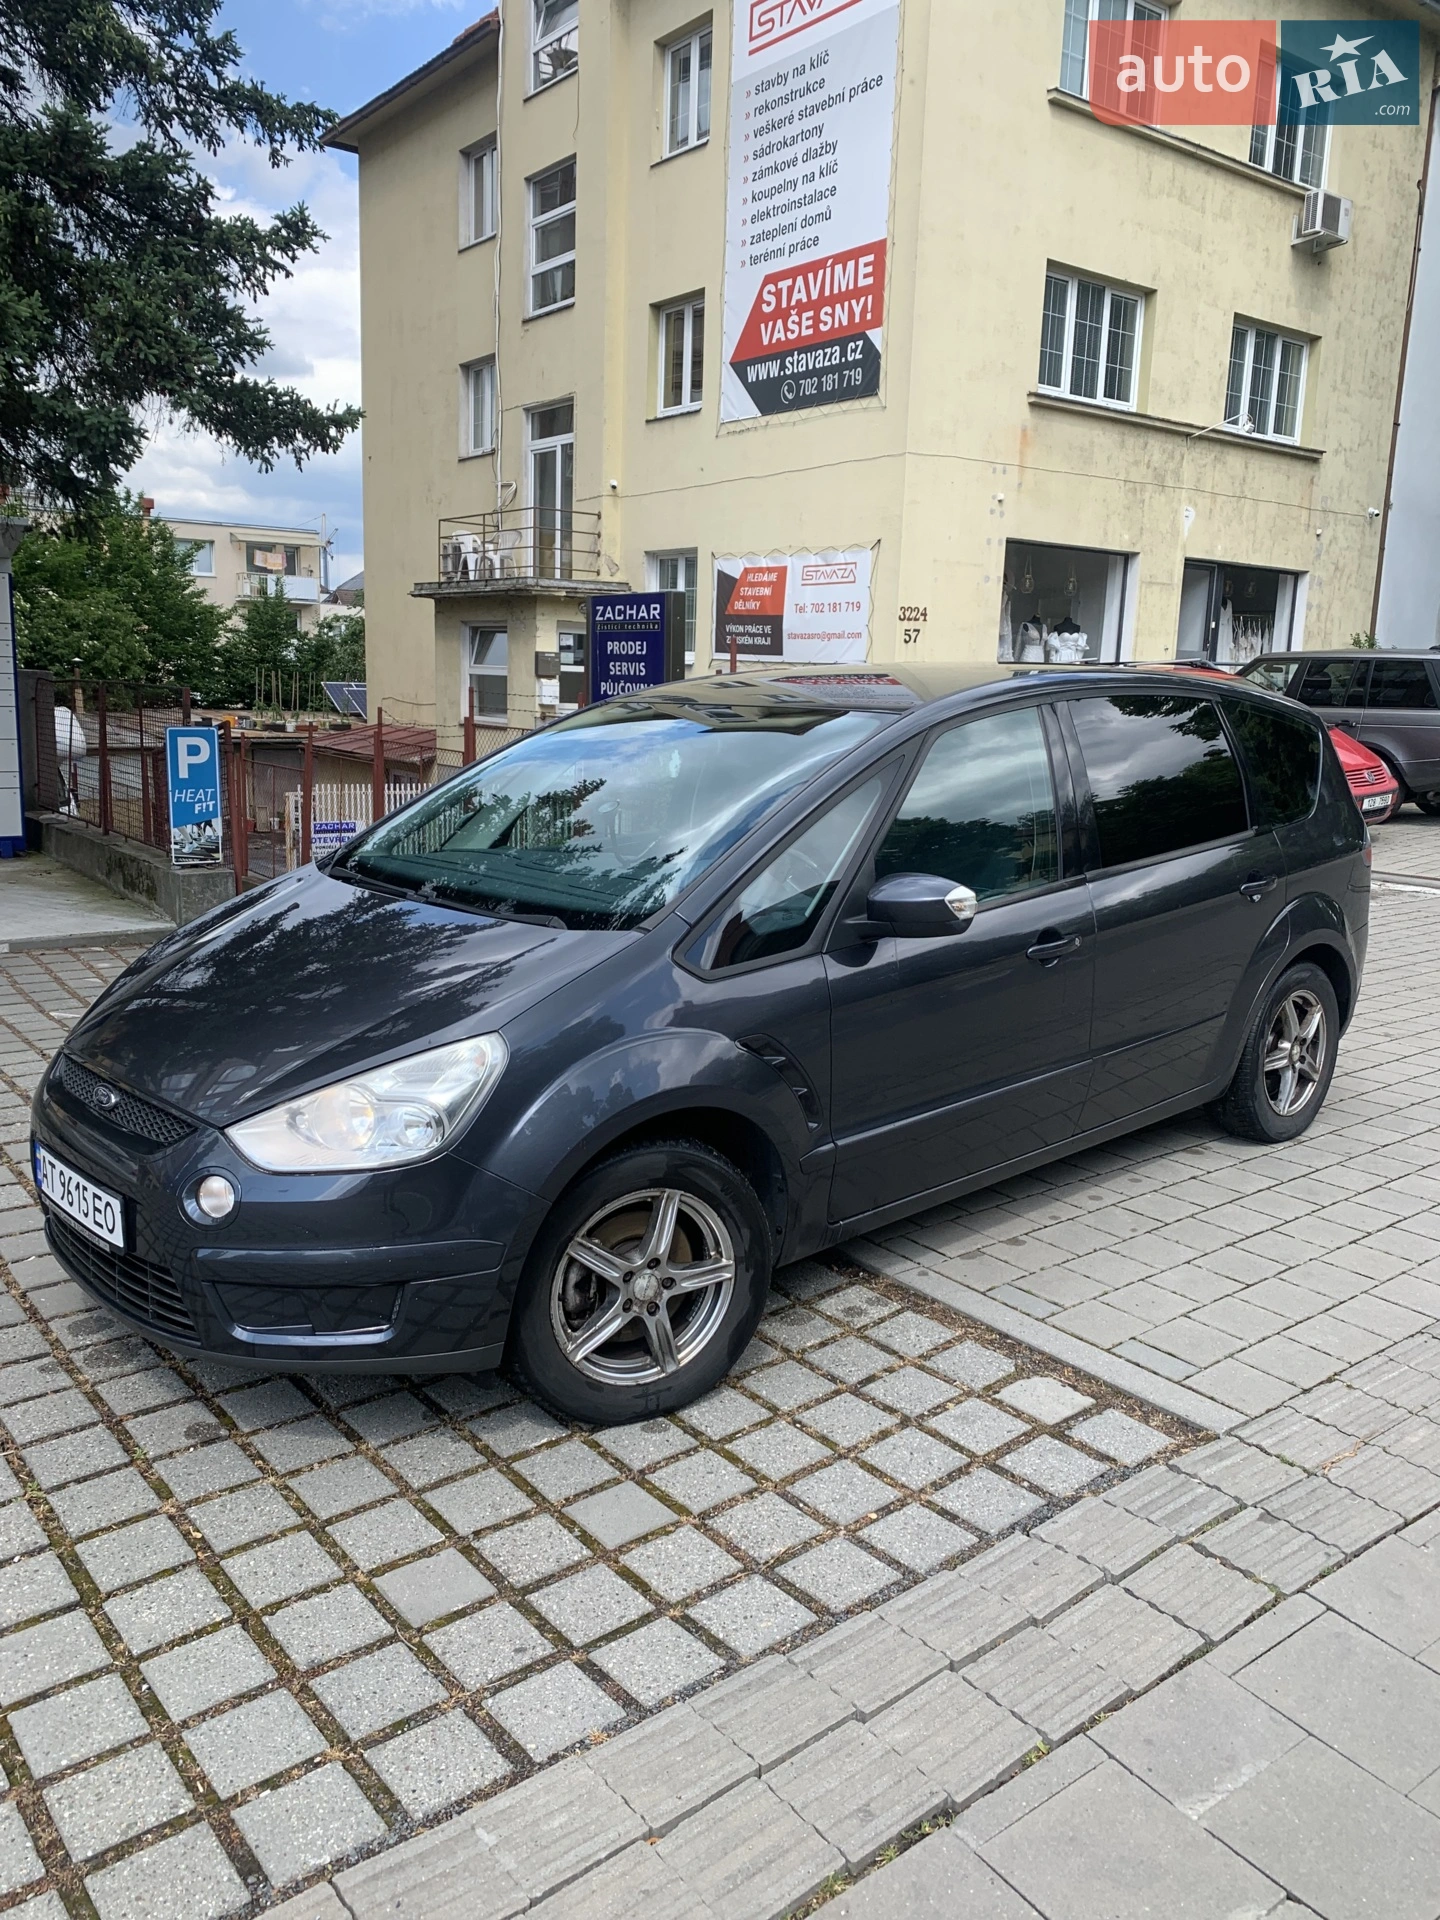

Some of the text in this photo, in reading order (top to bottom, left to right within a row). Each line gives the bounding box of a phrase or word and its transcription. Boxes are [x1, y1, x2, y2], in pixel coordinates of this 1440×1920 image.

[754, 49, 830, 95] stavby na klíč
[753, 74, 883, 139] veškeré stavební práce
[754, 78, 825, 117] rekonstrukce
[753, 122, 824, 160] sádrokartony
[752, 138, 838, 182] zámkové dlažby
[751, 159, 838, 203] koupelny na klíč
[751, 185, 837, 225] elektroinstalace
[750, 205, 832, 246] zateplení domů
[749, 235, 819, 266] terénní práce
[761, 254, 875, 313] STAVÍME
[760, 295, 872, 346] VAŠE SNY!
[747, 340, 863, 382] www.stavaza.cz
[799, 367, 862, 396] 702 181 719
[747, 571, 778, 582] HLEDÁME
[802, 566, 857, 582] STAVAZA
[740, 585, 772, 596] STAVEBNÍ
[595, 604, 660, 620] ZACHAR
[734, 599, 761, 610] DĚLNÍKY
[794, 601, 861, 613] Tel: 702 181 719
[898, 606, 928, 622] 3224
[624, 622, 659, 630] technika
[725, 623, 772, 634] VÝKON PRÁCE VE
[787, 630, 862, 641] stavazasro@gmail.com
[903, 628, 921, 644] 57
[607, 641, 647, 655] PRODEJ
[754, 636, 771, 645] KRAJI
[609, 661, 646, 676] SERVIS
[177, 737, 210, 779] P
[174, 789, 215, 802] HEAT
[59, 1169, 89, 1218] 9615
